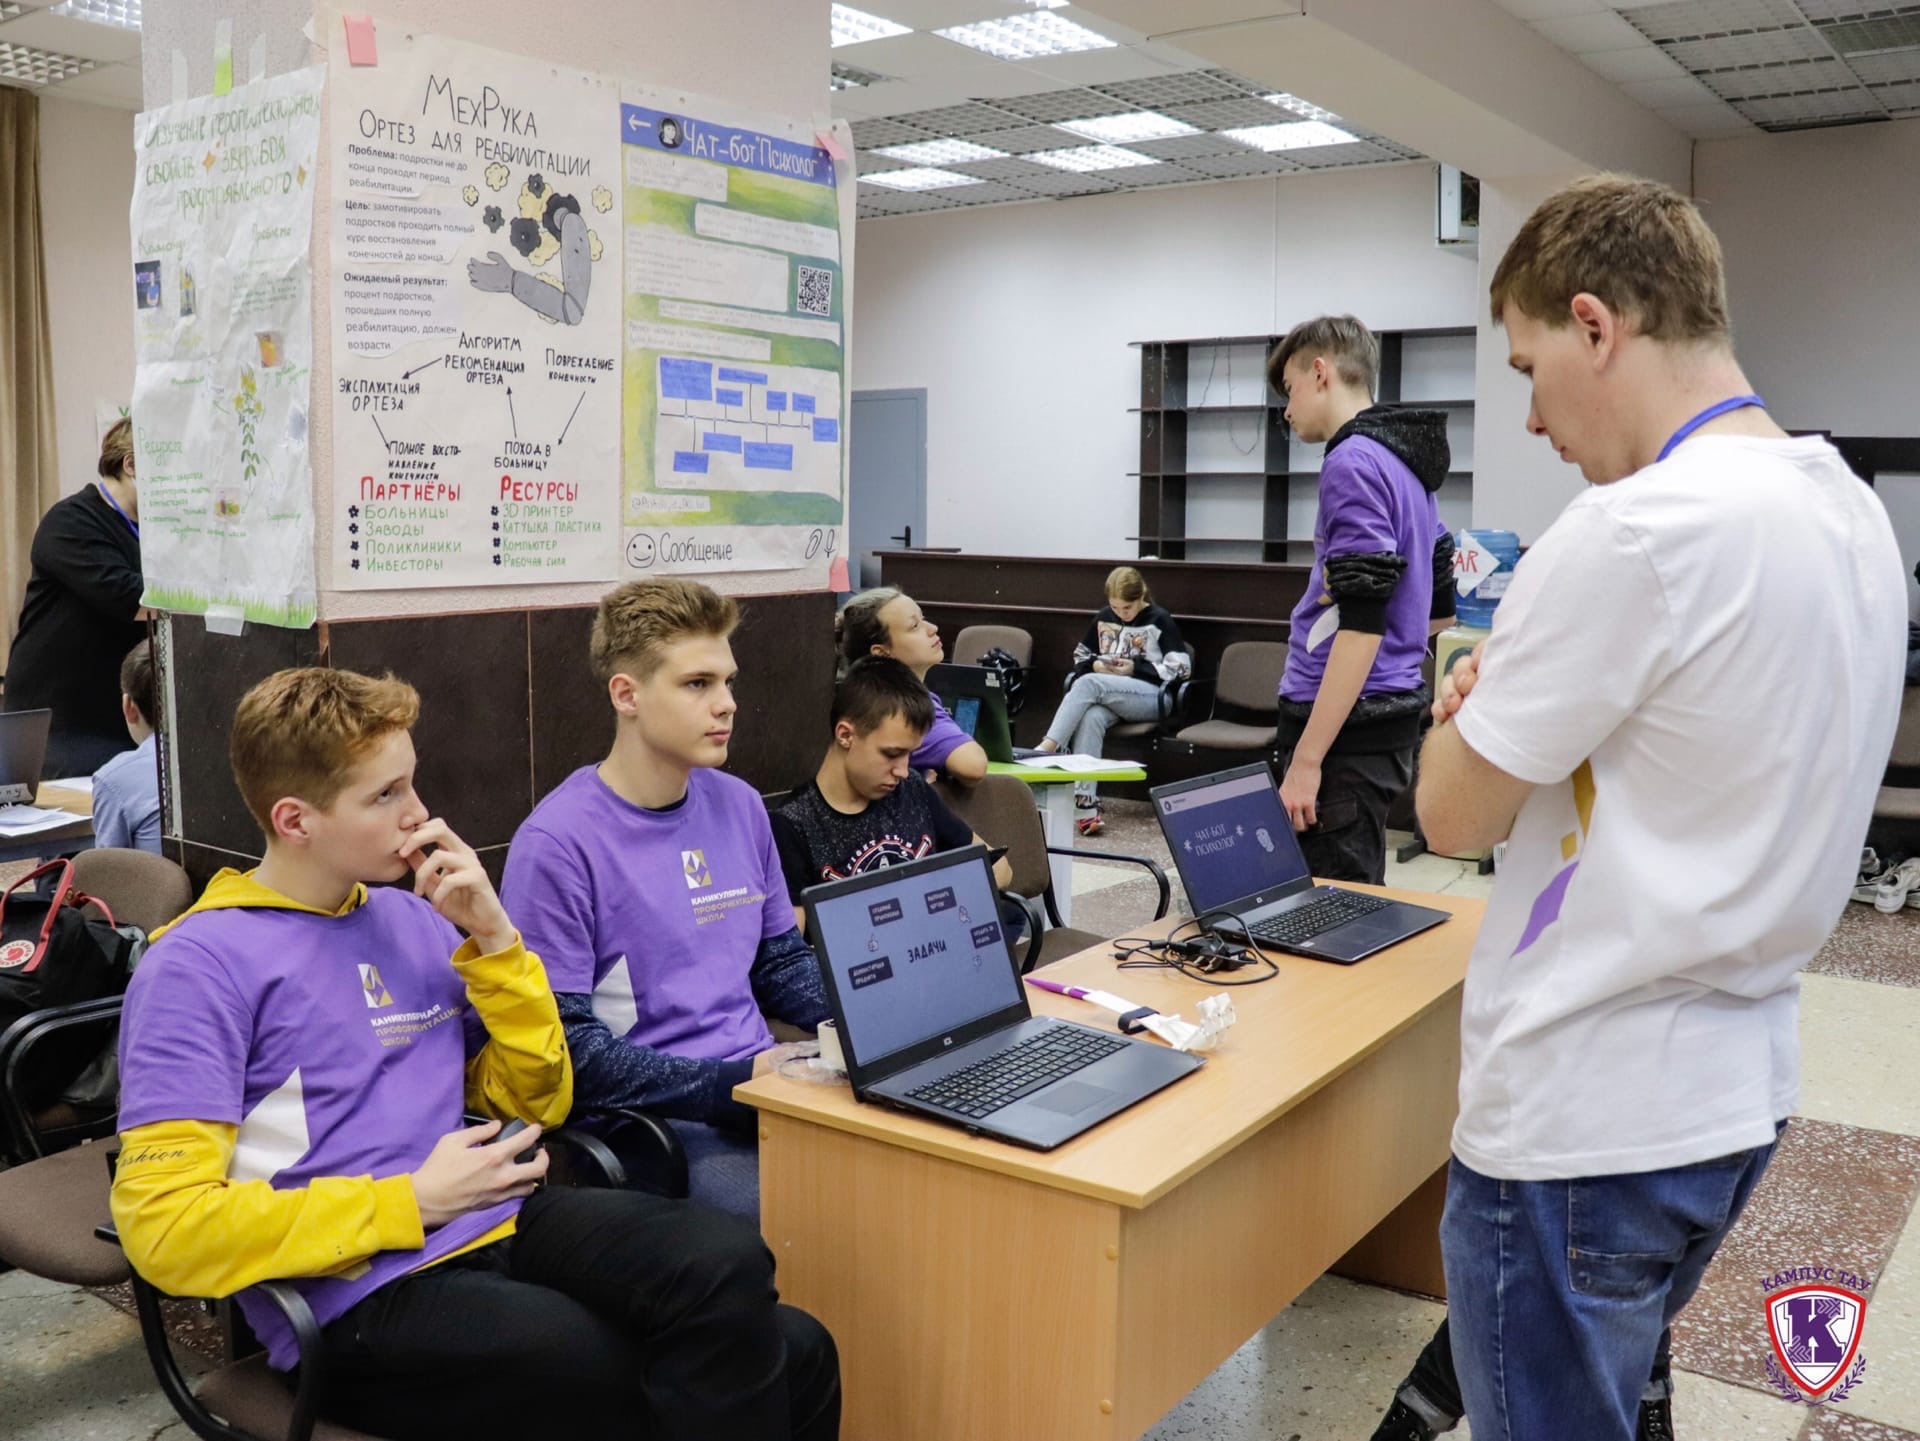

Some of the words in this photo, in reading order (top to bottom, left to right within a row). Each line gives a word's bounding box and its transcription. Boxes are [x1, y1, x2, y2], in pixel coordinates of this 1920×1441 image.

[348, 143, 398, 159] Проблема:
[399, 153, 443, 166] подростки
[445, 160, 455, 169] не
[457, 163, 468, 171] до
[348, 163, 376, 173] конца
[378, 166, 417, 179] проходят
[345, 200, 371, 211] Цель:
[373, 203, 442, 216] замотивировать
[345, 218, 397, 230] подростков
[398, 221, 442, 232] проходить
[443, 224, 475, 233] полный
[346, 234, 366, 245] курс
[368, 235, 436, 246] восстановления
[348, 250, 404, 260] конечностей
[405, 252, 416, 261] до
[343, 272, 401, 284] Ожидаемый
[403, 277, 448, 287] результат:
[344, 290, 380, 300] процент
[345, 306, 397, 316] прошедших
[399, 308, 432, 318] полную
[346, 322, 420, 335] реабилитацию,
[422, 326, 457, 335] должен
[445, 354, 525, 374] РЕКОМЕНДАЦИЯ
[466, 371, 504, 385] ОРТЕЗА
[339, 377, 421, 395] ЭКСПЛУАТАЦИЯ
[352, 395, 404, 412] ОРТЕЗА
[505, 441, 542, 456] ПОХОД
[545, 442, 551, 456] В
[494, 457, 548, 470] БОЛЬНИЦУ
[503, 503, 519, 518] 3D
[522, 504, 574, 518] ПРИНТЕР
[660, 532, 733, 563] Сообщение
[1453, 550, 1479, 573] AR
[696, 912, 725, 924] ШКОЛА
[907, 939, 948, 963] ЗАДАЧИ
[370, 1004, 441, 1027] КАНИКУЛЯРНАЯ
[381, 1036, 412, 1046] ШКОЛА
